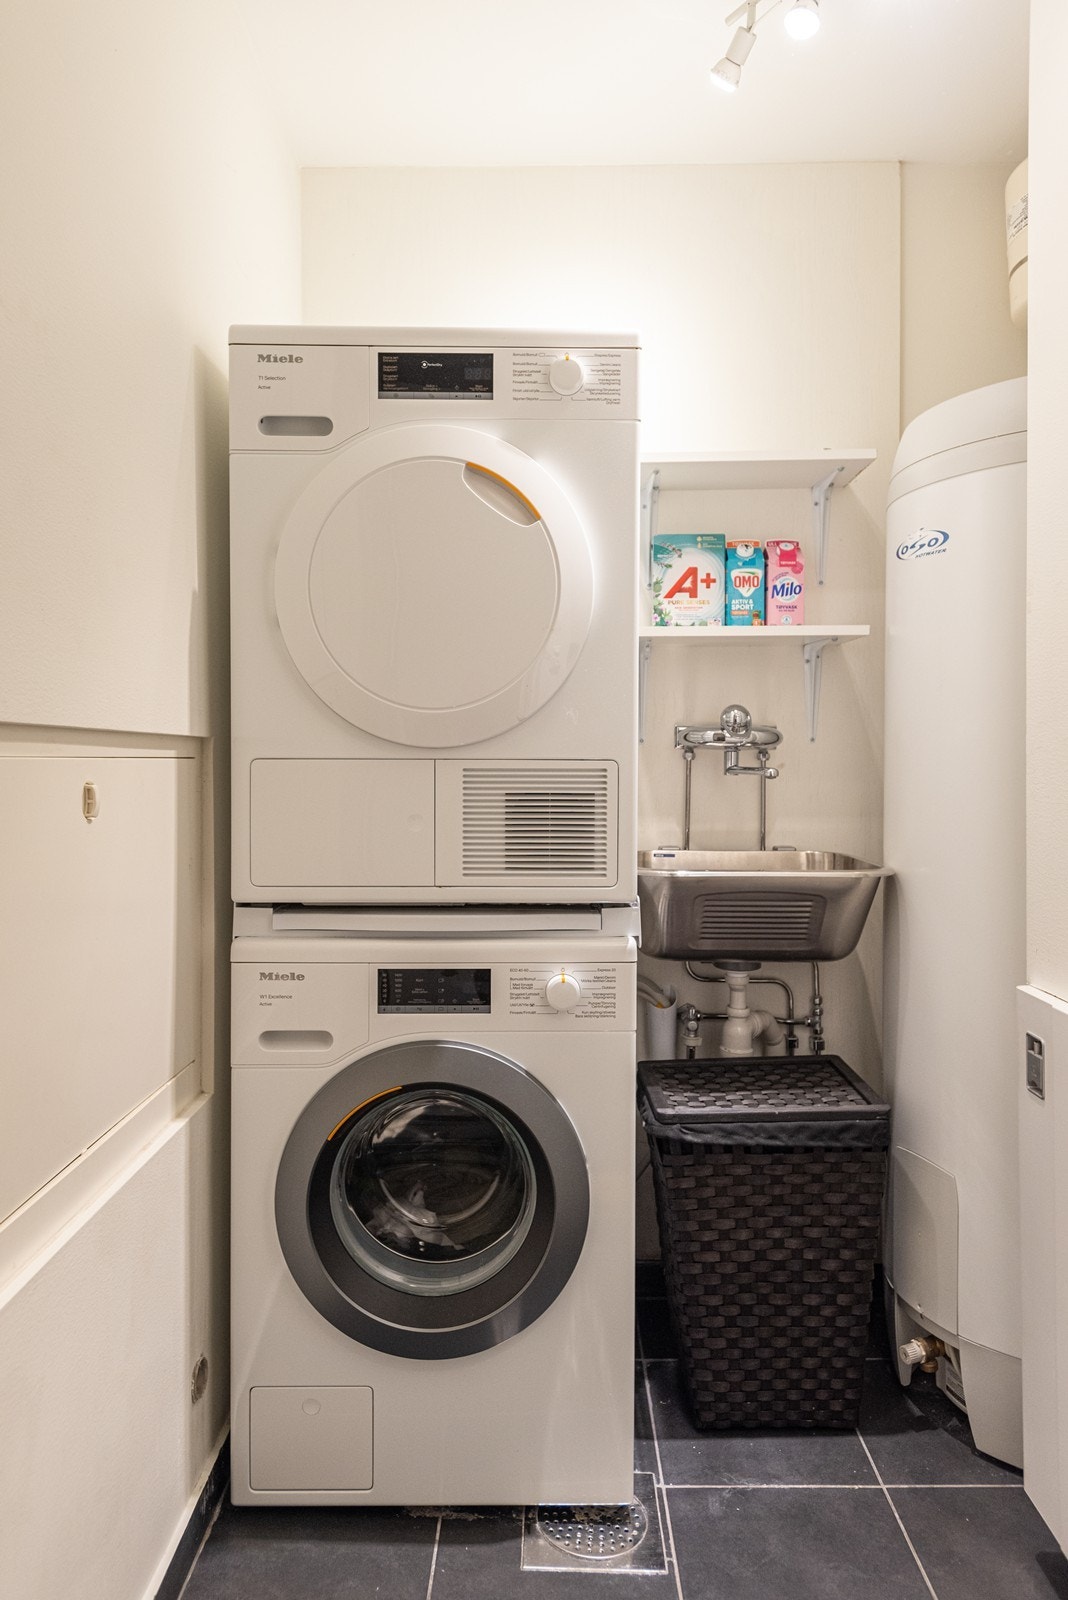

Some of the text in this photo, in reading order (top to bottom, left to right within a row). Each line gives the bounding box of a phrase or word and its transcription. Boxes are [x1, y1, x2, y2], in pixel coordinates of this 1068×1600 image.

[257, 353, 304, 363] Miele
[663, 566, 717, 599] A+
[734, 575, 760, 588] OMO
[771, 582, 802, 599] Milo
[259, 972, 306, 981] Miele
